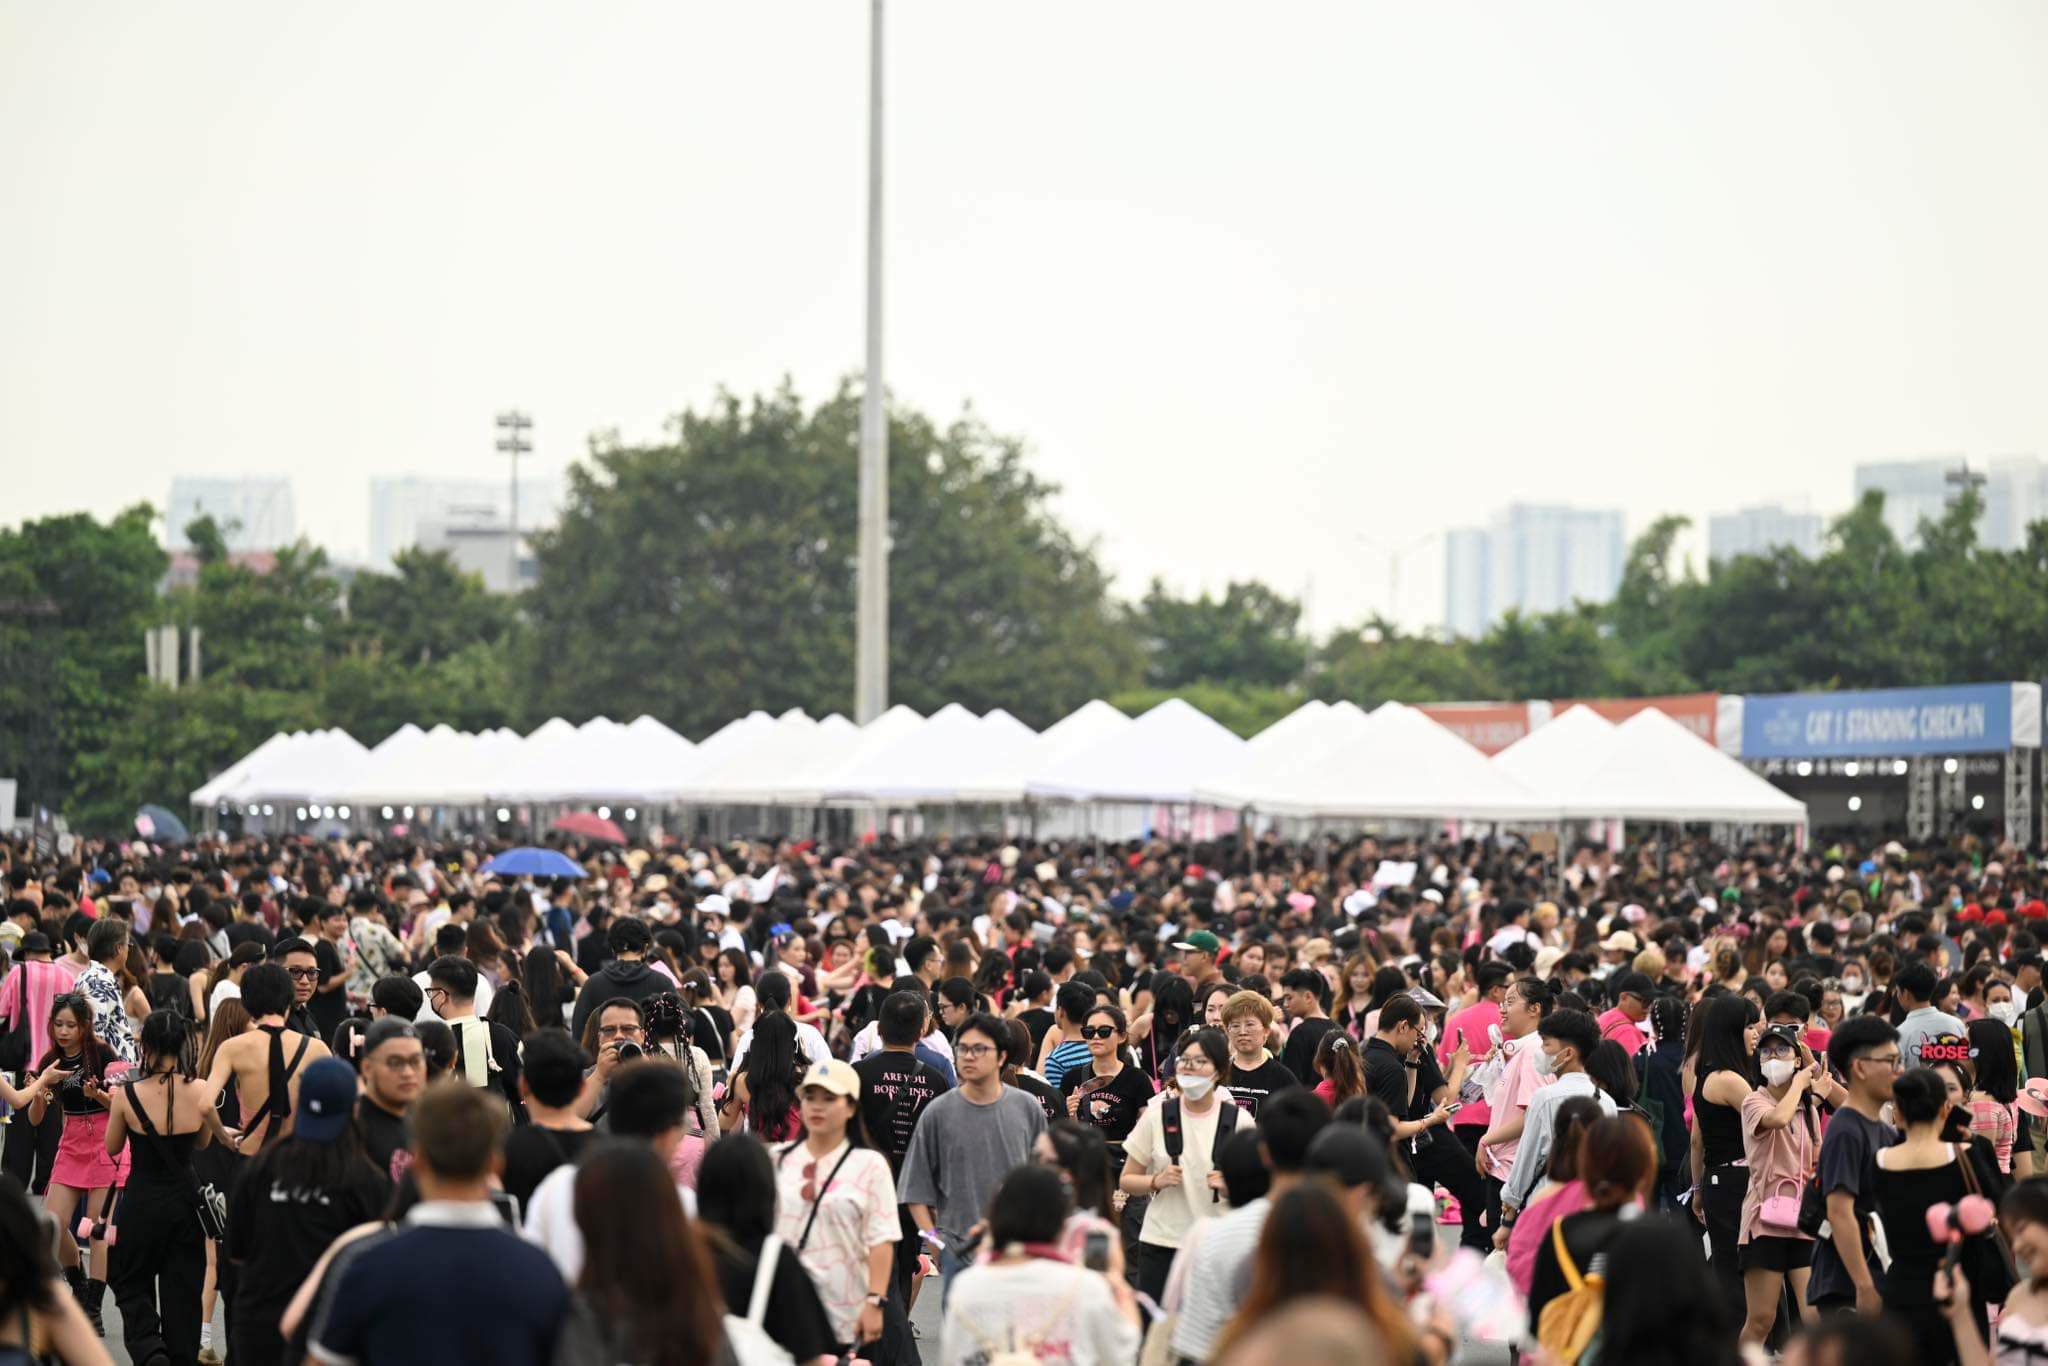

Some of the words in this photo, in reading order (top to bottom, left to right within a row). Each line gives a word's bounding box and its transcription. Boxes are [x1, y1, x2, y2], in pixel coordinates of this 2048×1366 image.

[1806, 710, 1832, 745] CAT
[1846, 705, 1917, 743] STANDING
[1920, 703, 1986, 740] CHECK-IN
[883, 1072, 901, 1081] ARE
